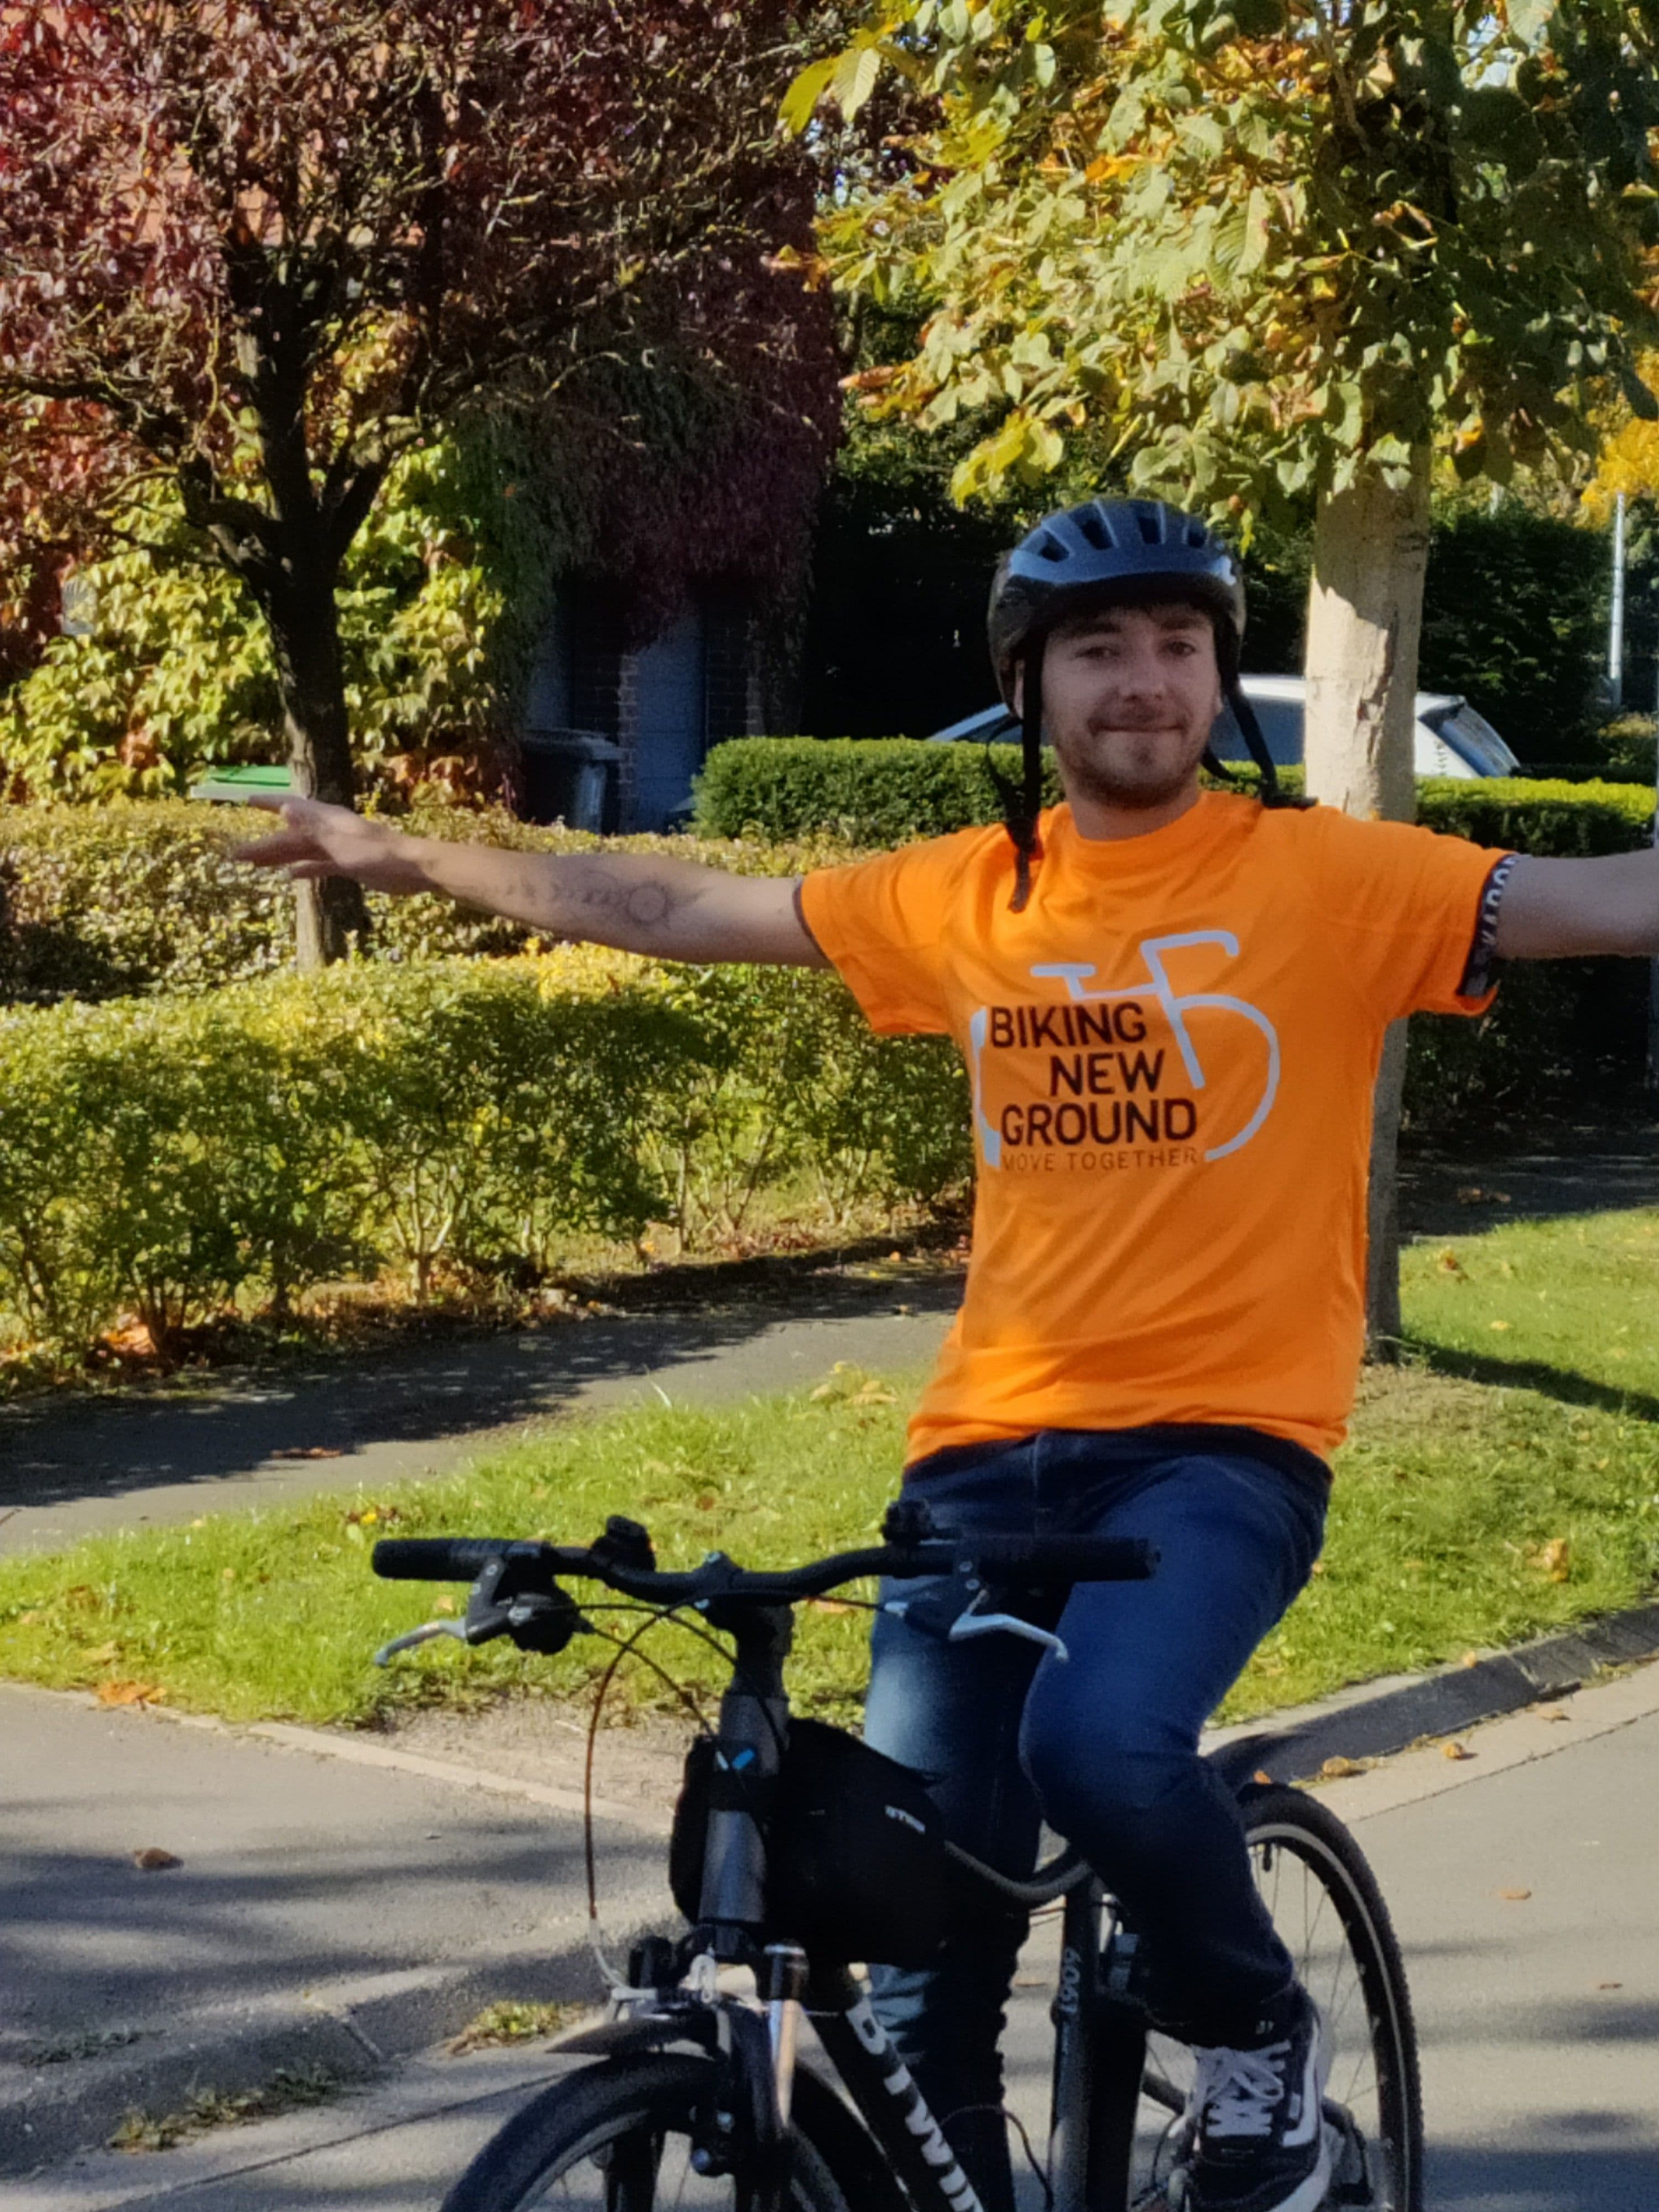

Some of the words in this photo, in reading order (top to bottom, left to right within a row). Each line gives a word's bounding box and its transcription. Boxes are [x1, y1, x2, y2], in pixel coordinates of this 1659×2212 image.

[990, 1002, 1147, 1048] BIKING
[1050, 1049, 1165, 1097] NEW
[1001, 1098, 1197, 1146] GROUND
[1002, 1152, 1056, 1172] MOVE
[1066, 1147, 1198, 1171] TOGETHER
